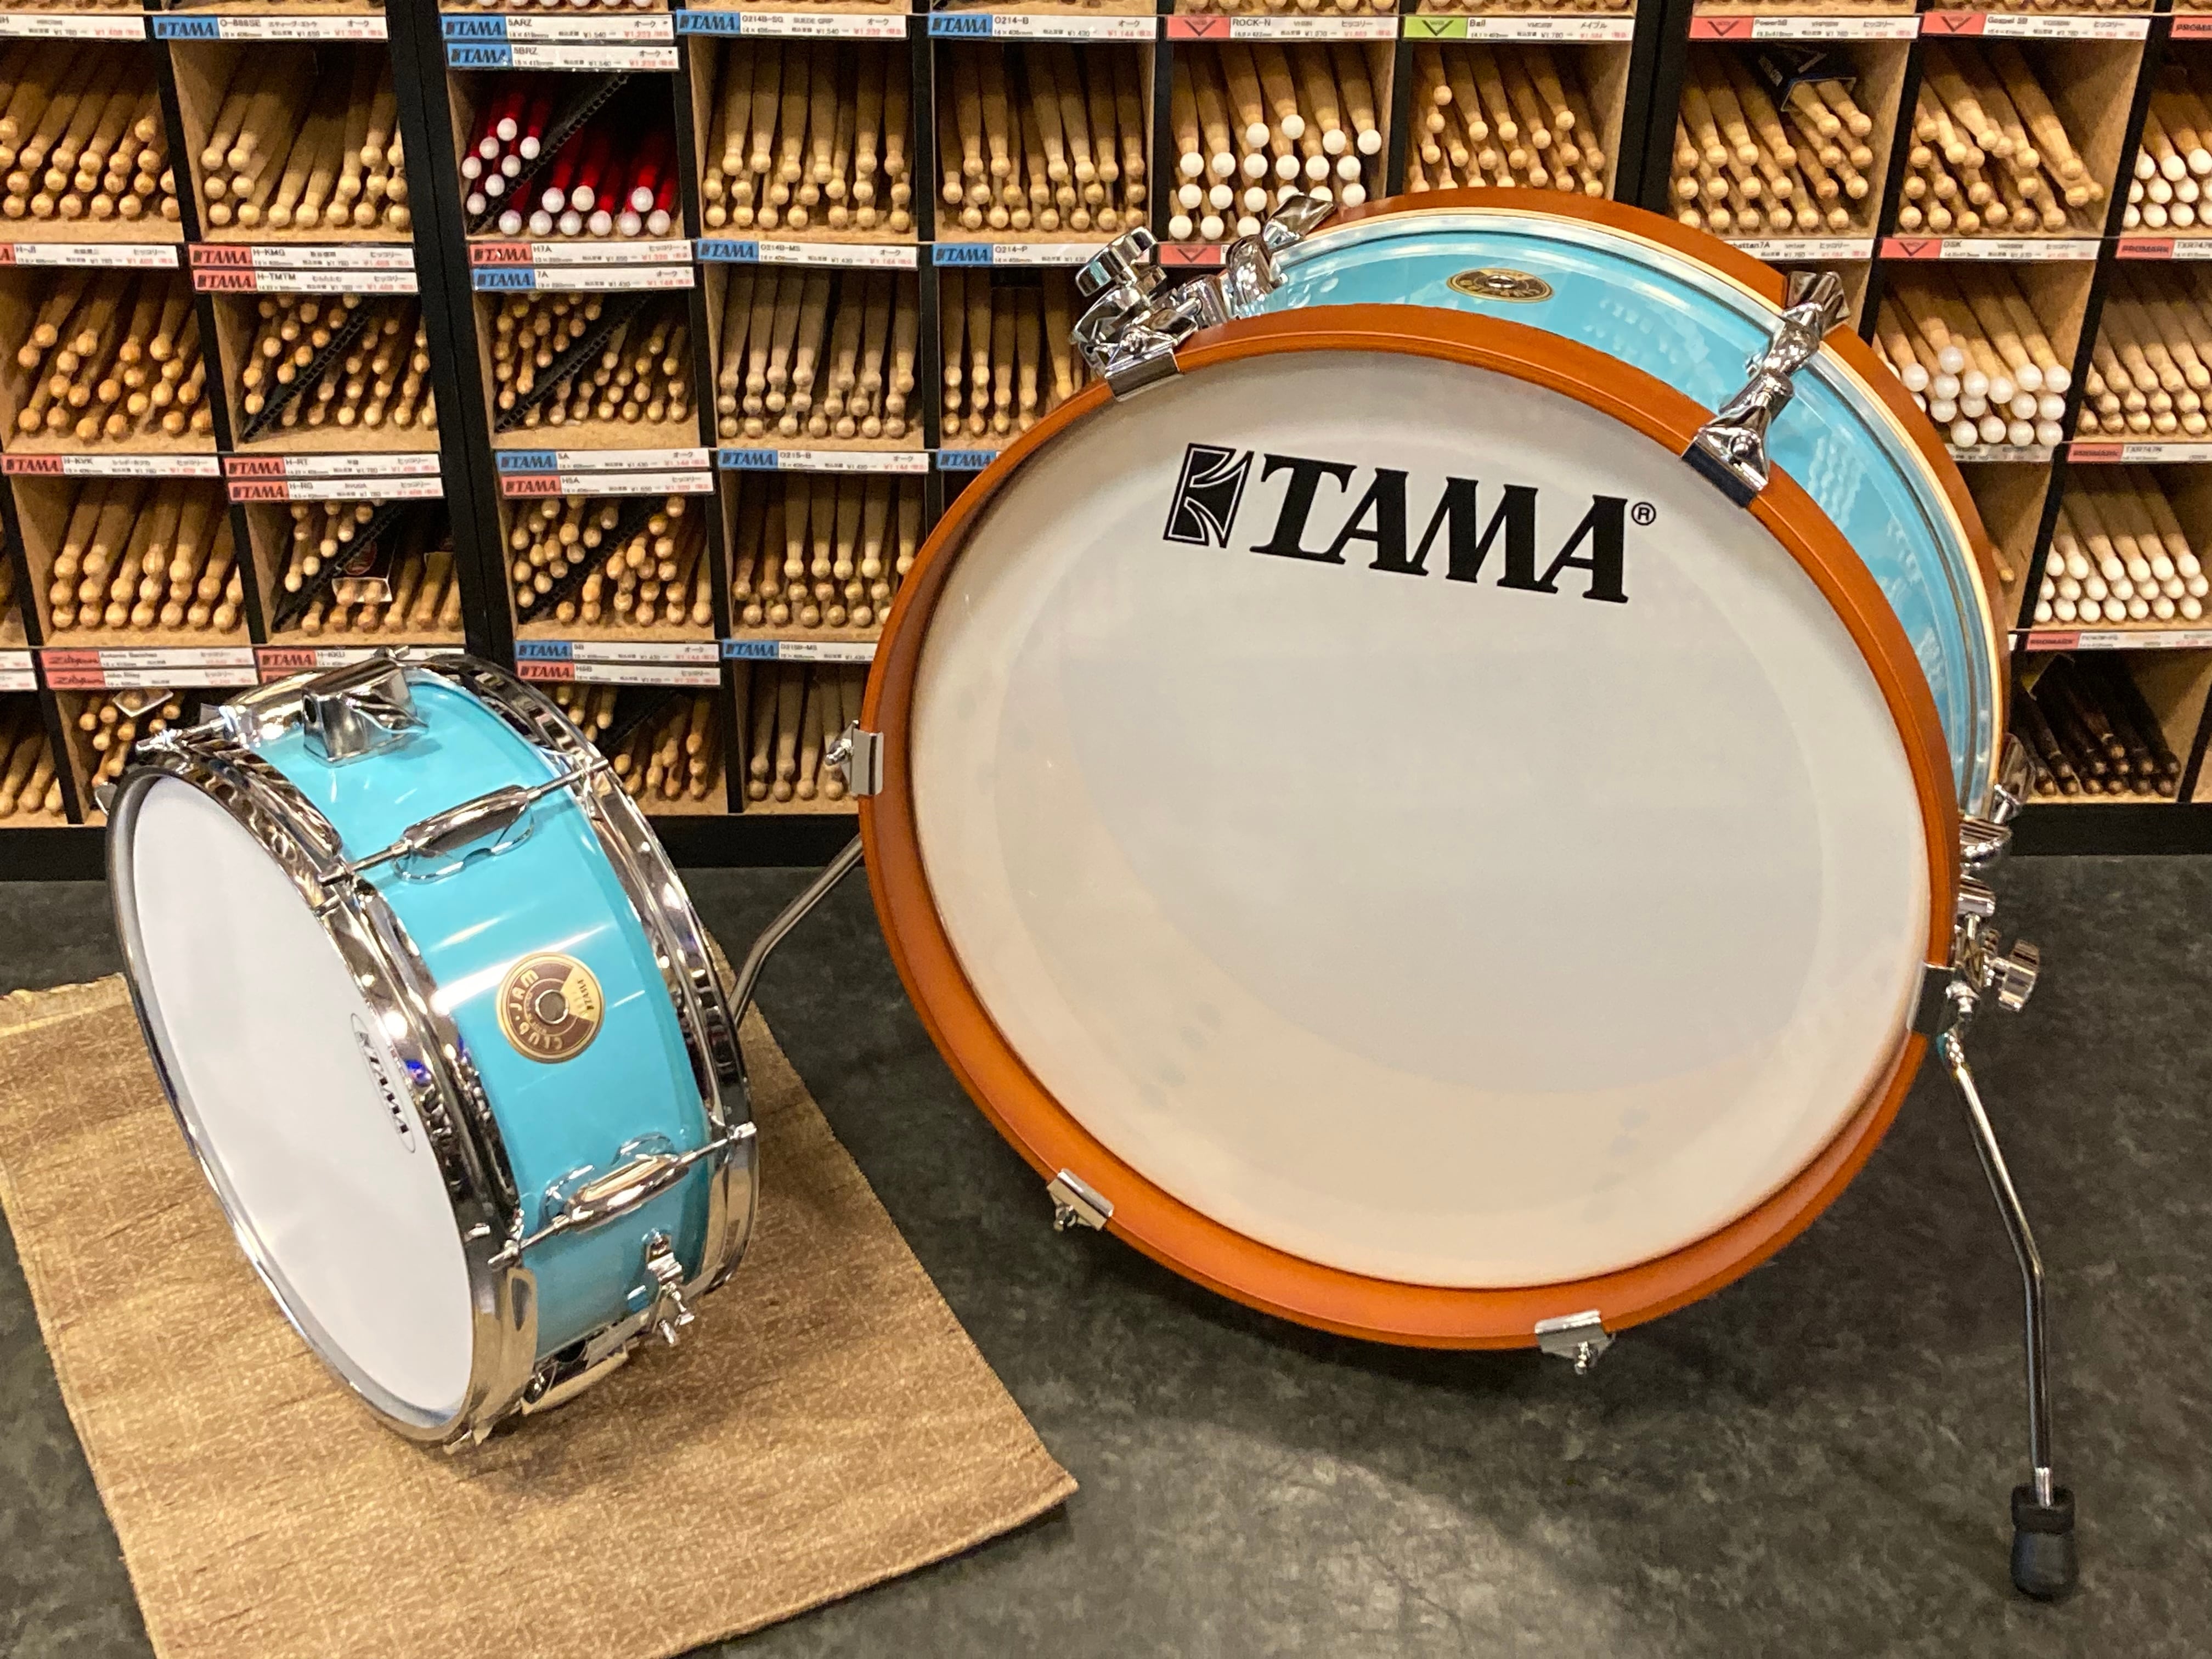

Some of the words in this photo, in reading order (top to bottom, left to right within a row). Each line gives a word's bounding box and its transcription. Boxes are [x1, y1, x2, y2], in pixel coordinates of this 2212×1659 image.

[691, 15, 735, 30] TAMA
[944, 18, 988, 32] TAMA
[995, 16, 1029, 25] O214-B
[1233, 18, 1271, 26] ROCK-N
[166, 22, 215, 36] TAMA
[459, 21, 502, 35] TAMA
[463, 49, 507, 63] TAMA
[204, 251, 247, 263] TAMA
[485, 249, 528, 261] TAMA
[713, 244, 754, 258] TAMA
[946, 248, 988, 262] TAMA
[208, 275, 252, 288] TAMA
[489, 273, 532, 286] TAMA
[511, 456, 553, 469] TAMA
[731, 453, 773, 465] TAMA
[951, 454, 991, 466] TAMA
[15, 459, 59, 472] TAMA
[240, 462, 282, 475] TAMA
[244, 486, 285, 498] TAMA
[516, 481, 557, 493] TAMA
[530, 645, 568, 656] TAMA
[738, 645, 775, 657] TAMA
[273, 654, 312, 666] TAMA
[532, 666, 570, 678] TAMA
